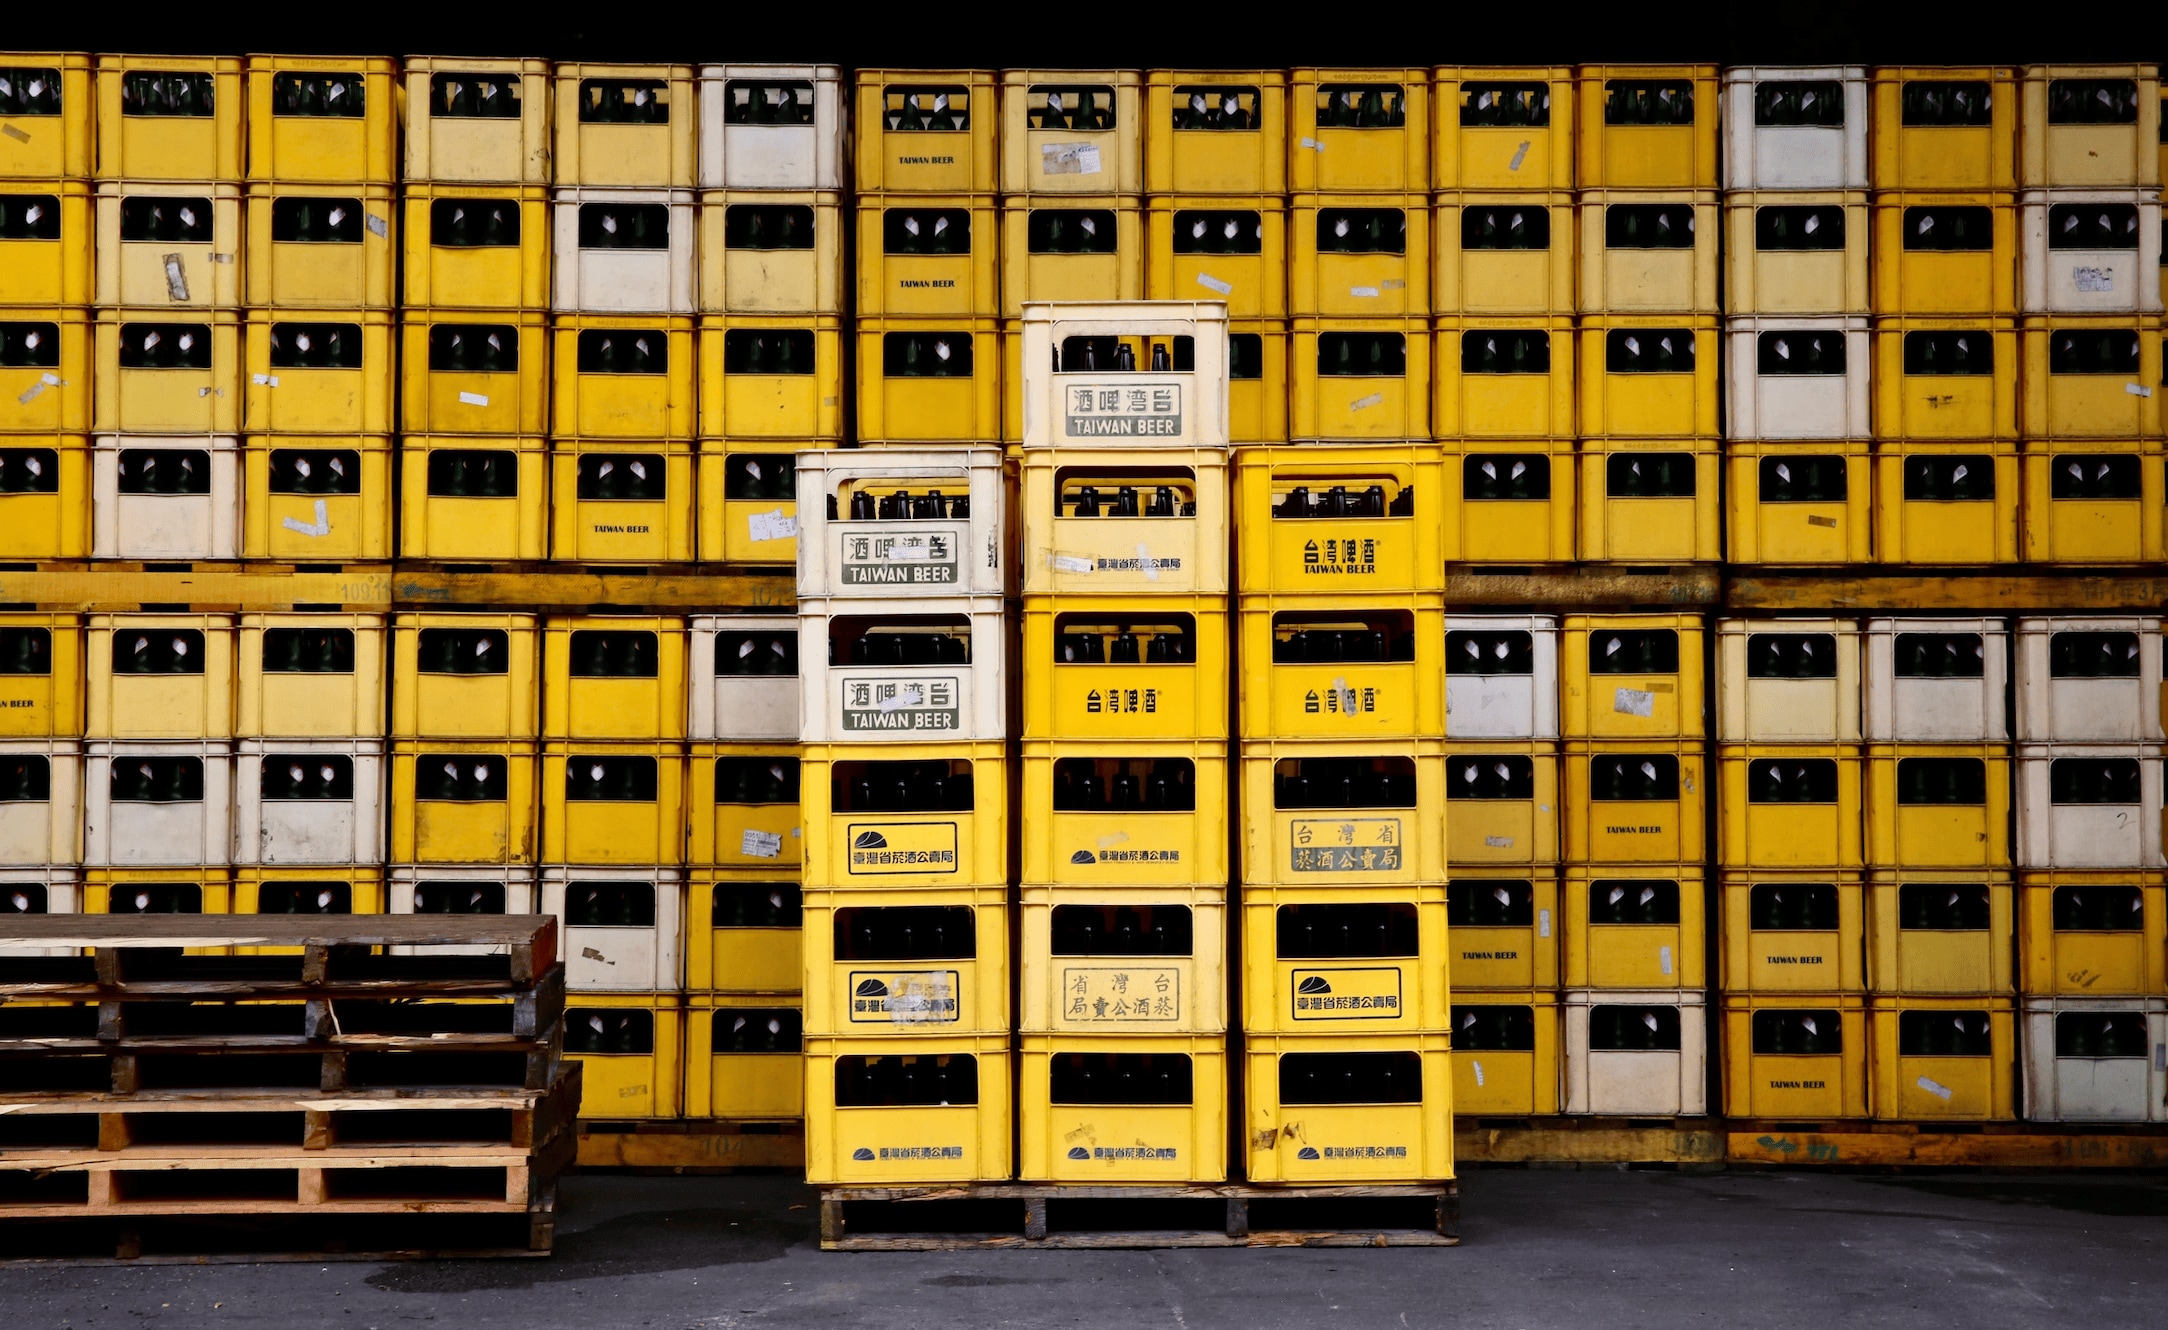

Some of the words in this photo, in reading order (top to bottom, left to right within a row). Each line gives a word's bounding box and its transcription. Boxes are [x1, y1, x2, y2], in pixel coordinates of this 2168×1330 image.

[899, 156, 929, 164] TAIWAN
[931, 156, 954, 164] BEER
[900, 280, 930, 288] TAIWAN
[932, 280, 955, 288] BEER
[1074, 419, 1132, 434] TAIWAN
[1137, 419, 1174, 434] BEER
[594, 525, 624, 533] TAIWAN
[626, 525, 649, 533] BEER
[1304, 564, 1343, 574] TAIWAN
[1346, 564, 1376, 574] BEER
[850, 566, 908, 582] TAIWAN
[913, 566, 951, 582] BEER
[10, 700, 34, 708] BEER
[851, 712, 909, 728] TAIWAN
[914, 712, 952, 728] BEER
[2116, 812, 2136, 830] 2
[1606, 826, 1636, 834] TAIWAN
[1639, 826, 1662, 834] BEER
[1296, 848, 1398, 870] 菸酒公賣局
[1462, 951, 1493, 959] TAIWAN
[1495, 951, 1518, 959] BEER
[1767, 956, 1798, 964] TAIWAN
[1800, 956, 1823, 964] BEER
[1770, 1081, 1800, 1089] TAIWAN
[1803, 1081, 1826, 1089] BEER
